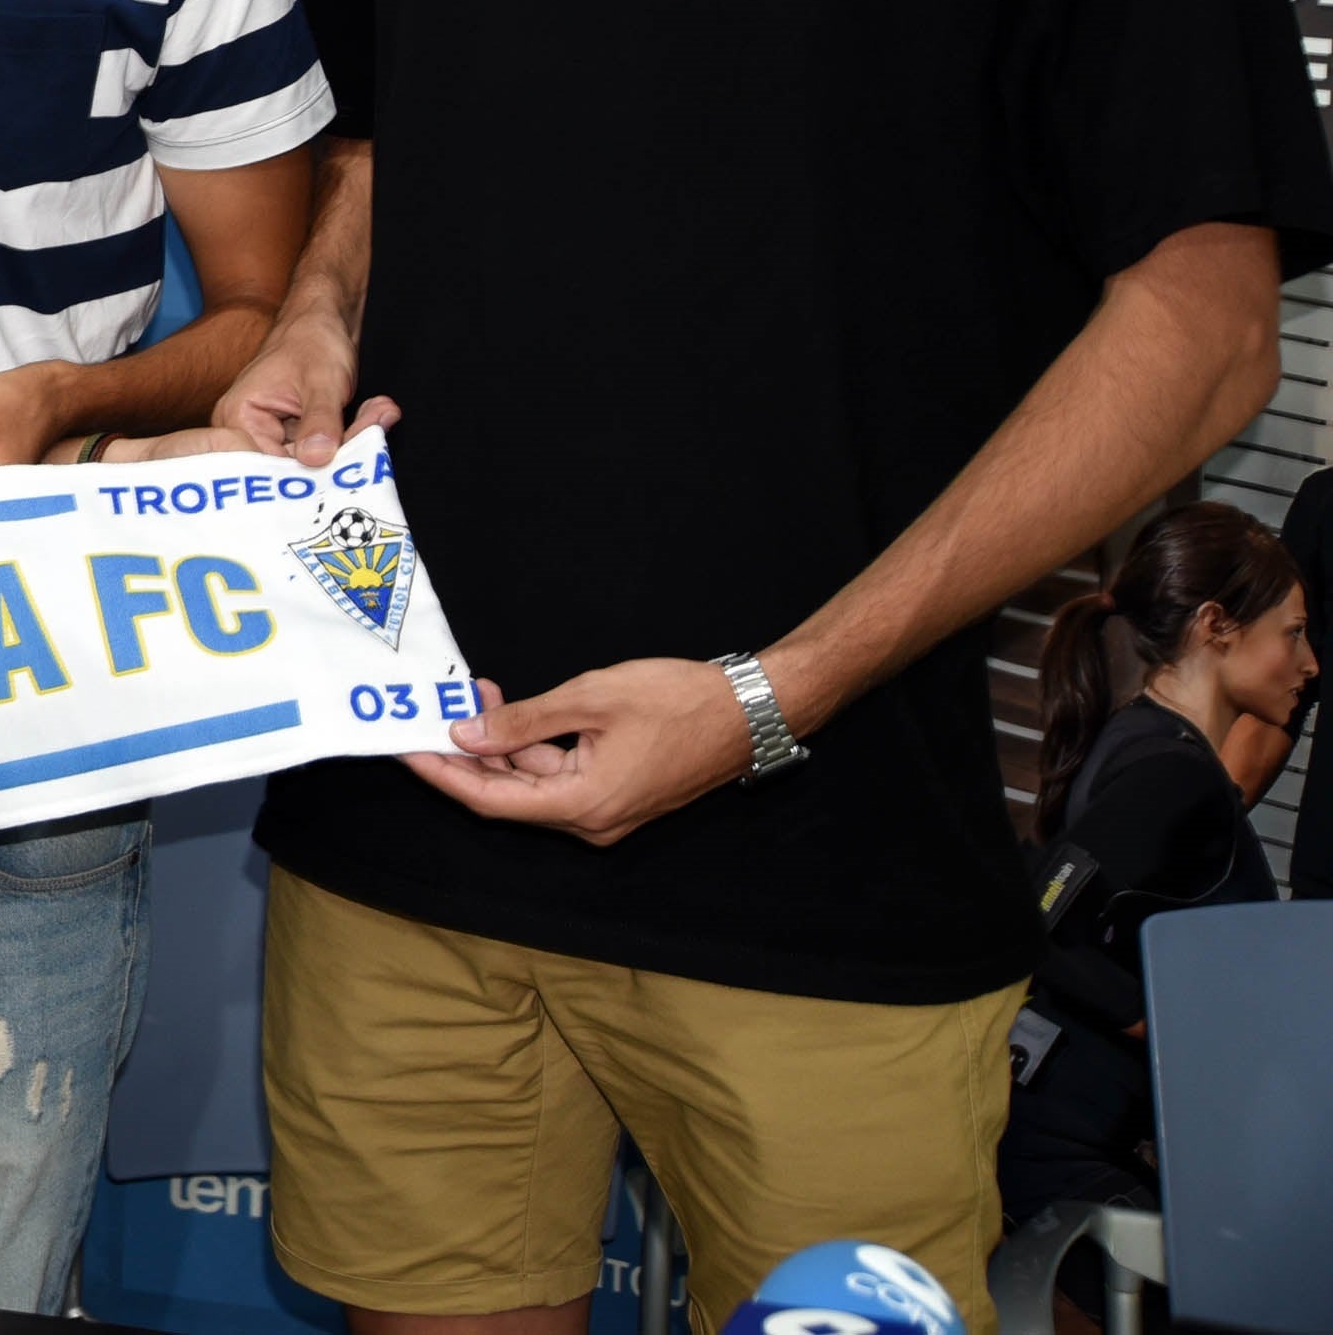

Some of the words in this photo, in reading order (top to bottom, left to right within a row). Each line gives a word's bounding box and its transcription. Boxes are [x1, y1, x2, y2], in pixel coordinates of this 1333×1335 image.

[98, 475, 316, 516] TROFEO
[85, 551, 276, 676] FC
[296, 547, 380, 632] MARBELLA
[350, 682, 420, 722] 03
